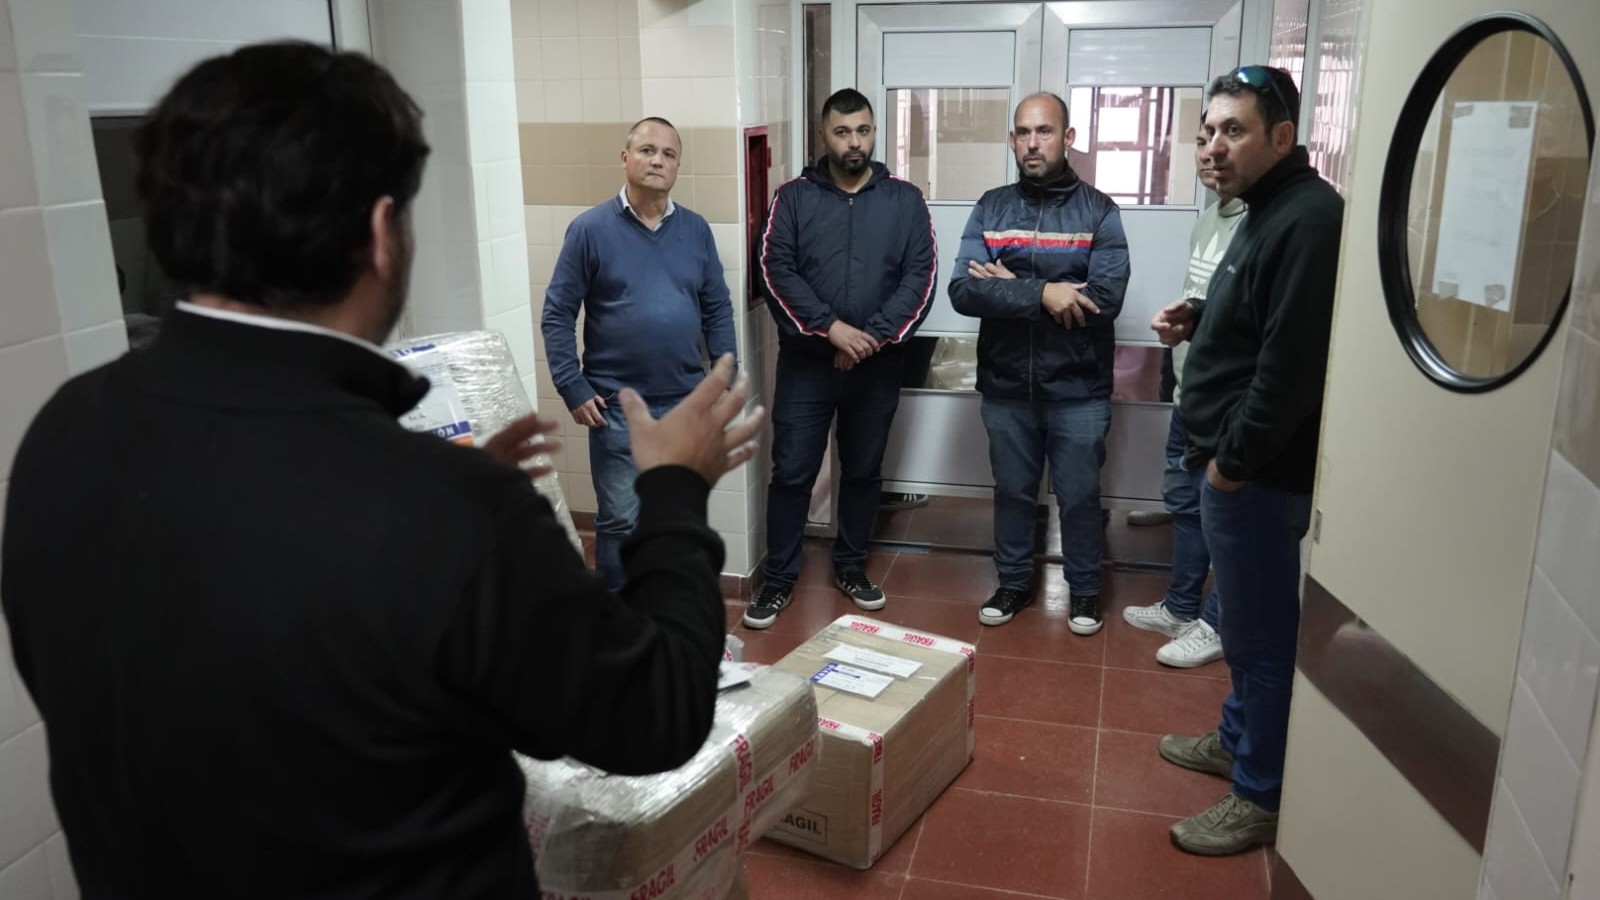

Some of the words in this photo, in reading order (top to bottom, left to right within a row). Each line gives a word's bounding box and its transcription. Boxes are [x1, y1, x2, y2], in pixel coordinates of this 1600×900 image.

[850, 621, 880, 634] FRAGIL
[904, 632, 936, 647] FRAGIL
[732, 733, 753, 793] FRAGIL
[788, 739, 816, 776] FRAGIL
[743, 776, 774, 815] FRAGIL
[871, 788, 882, 826] FRAGIL
[693, 816, 729, 862] FRAGIL
[781, 813, 822, 836] AGIL
